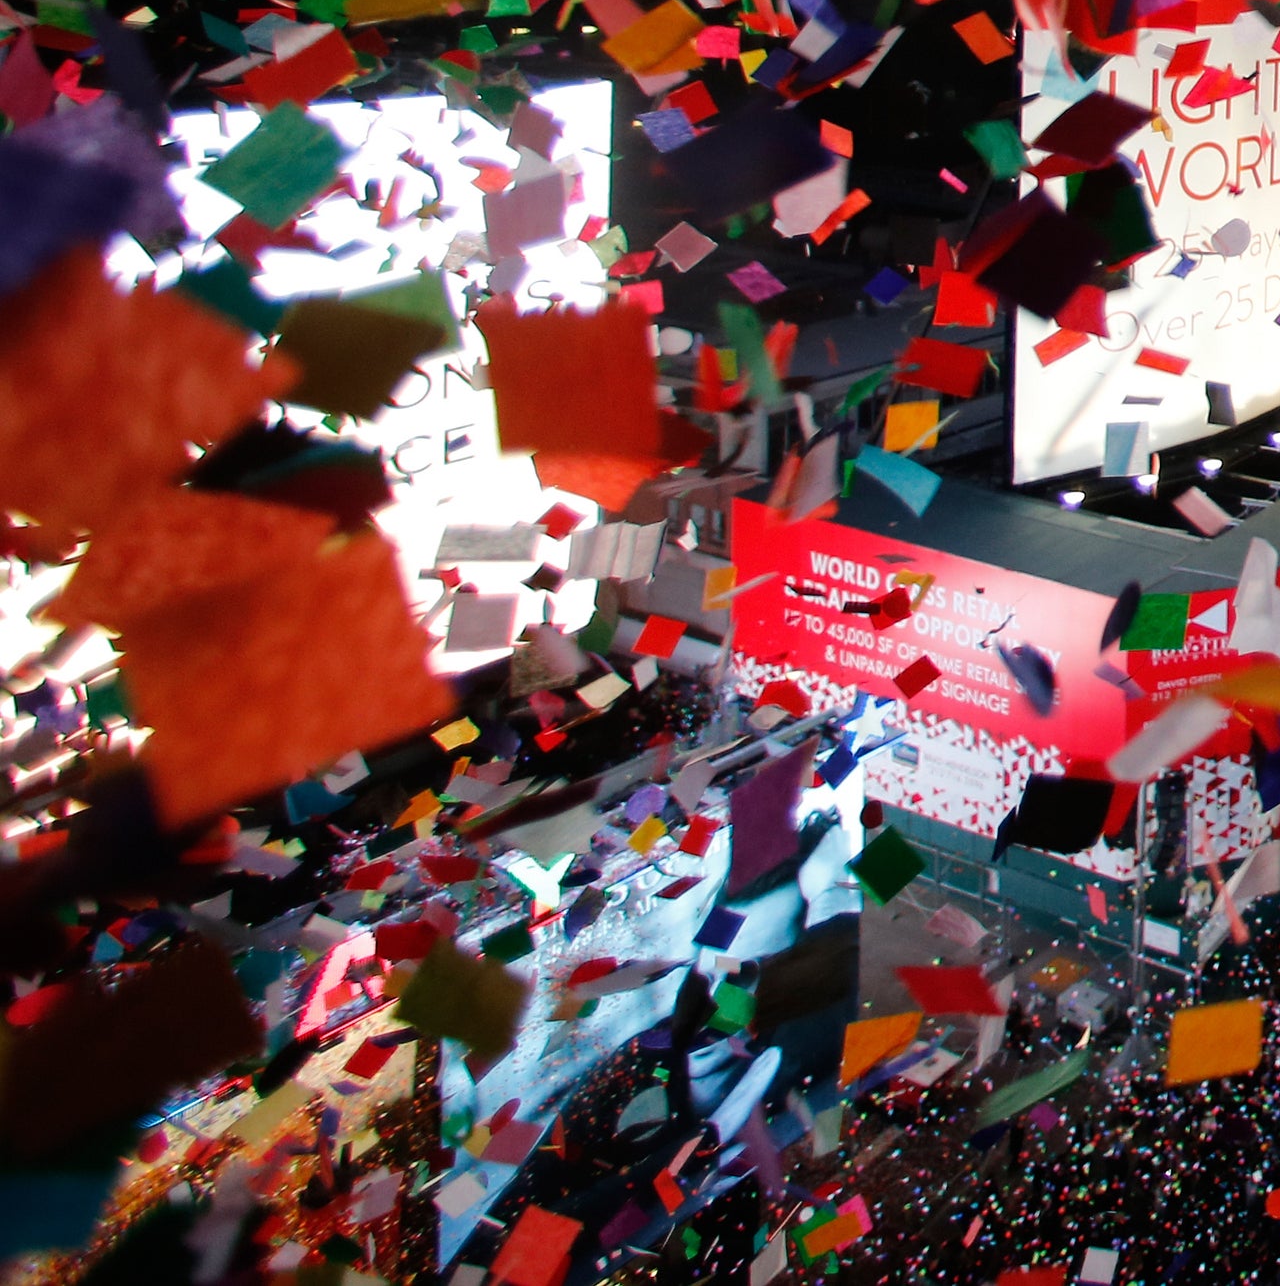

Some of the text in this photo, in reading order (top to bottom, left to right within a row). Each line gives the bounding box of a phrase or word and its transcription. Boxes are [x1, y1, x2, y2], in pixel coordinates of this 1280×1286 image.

[1097, 310, 1204, 352] Over
[1214, 284, 1255, 331] 25
[809, 550, 881, 591] WORLD
[952, 591, 1021, 631] RETAIL
[804, 615, 826, 634] TO
[827, 623, 875, 650] 45,000
[878, 636, 894, 655] SF
[897, 642, 917, 663] OF
[966, 662, 1011, 691] RETAIL
[824, 644, 837, 664] &
[940, 680, 1011, 716] SIGNAGE
